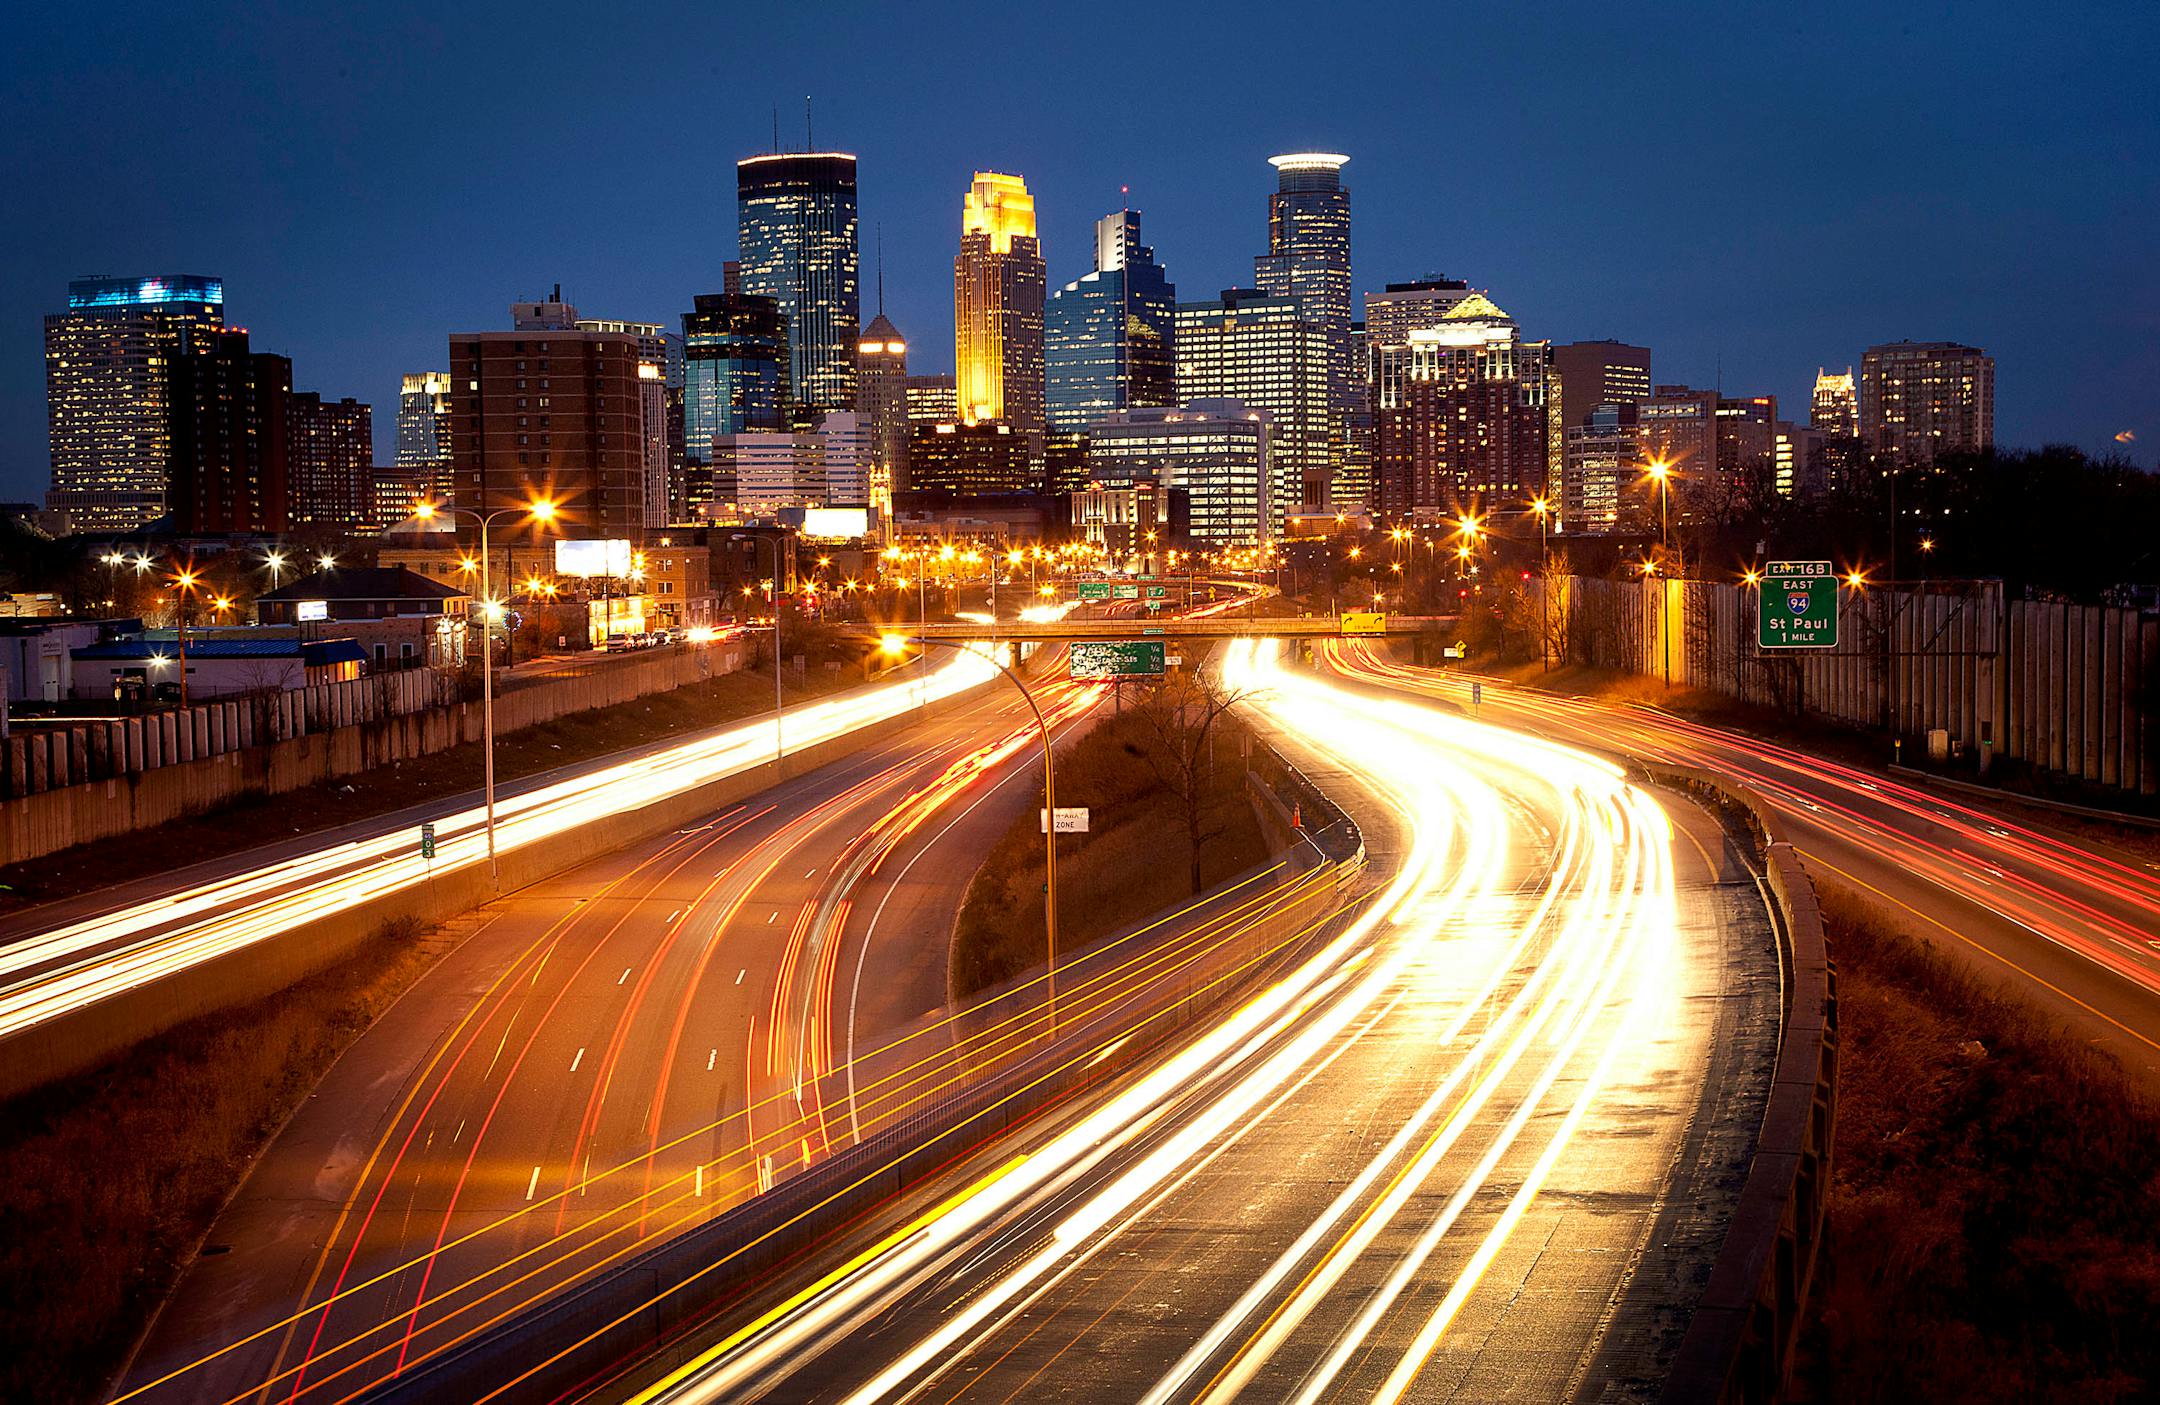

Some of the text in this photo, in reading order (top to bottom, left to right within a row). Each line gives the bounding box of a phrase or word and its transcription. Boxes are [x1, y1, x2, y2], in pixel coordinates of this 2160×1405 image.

[1800, 564, 1825, 575] 16B
[1783, 580, 1814, 589] EAST
[1790, 598, 1806, 608] 94
[1769, 618, 1827, 629] St Paul
[1781, 632, 1815, 642] 1 MILE
[425, 840, 432, 848] 0
